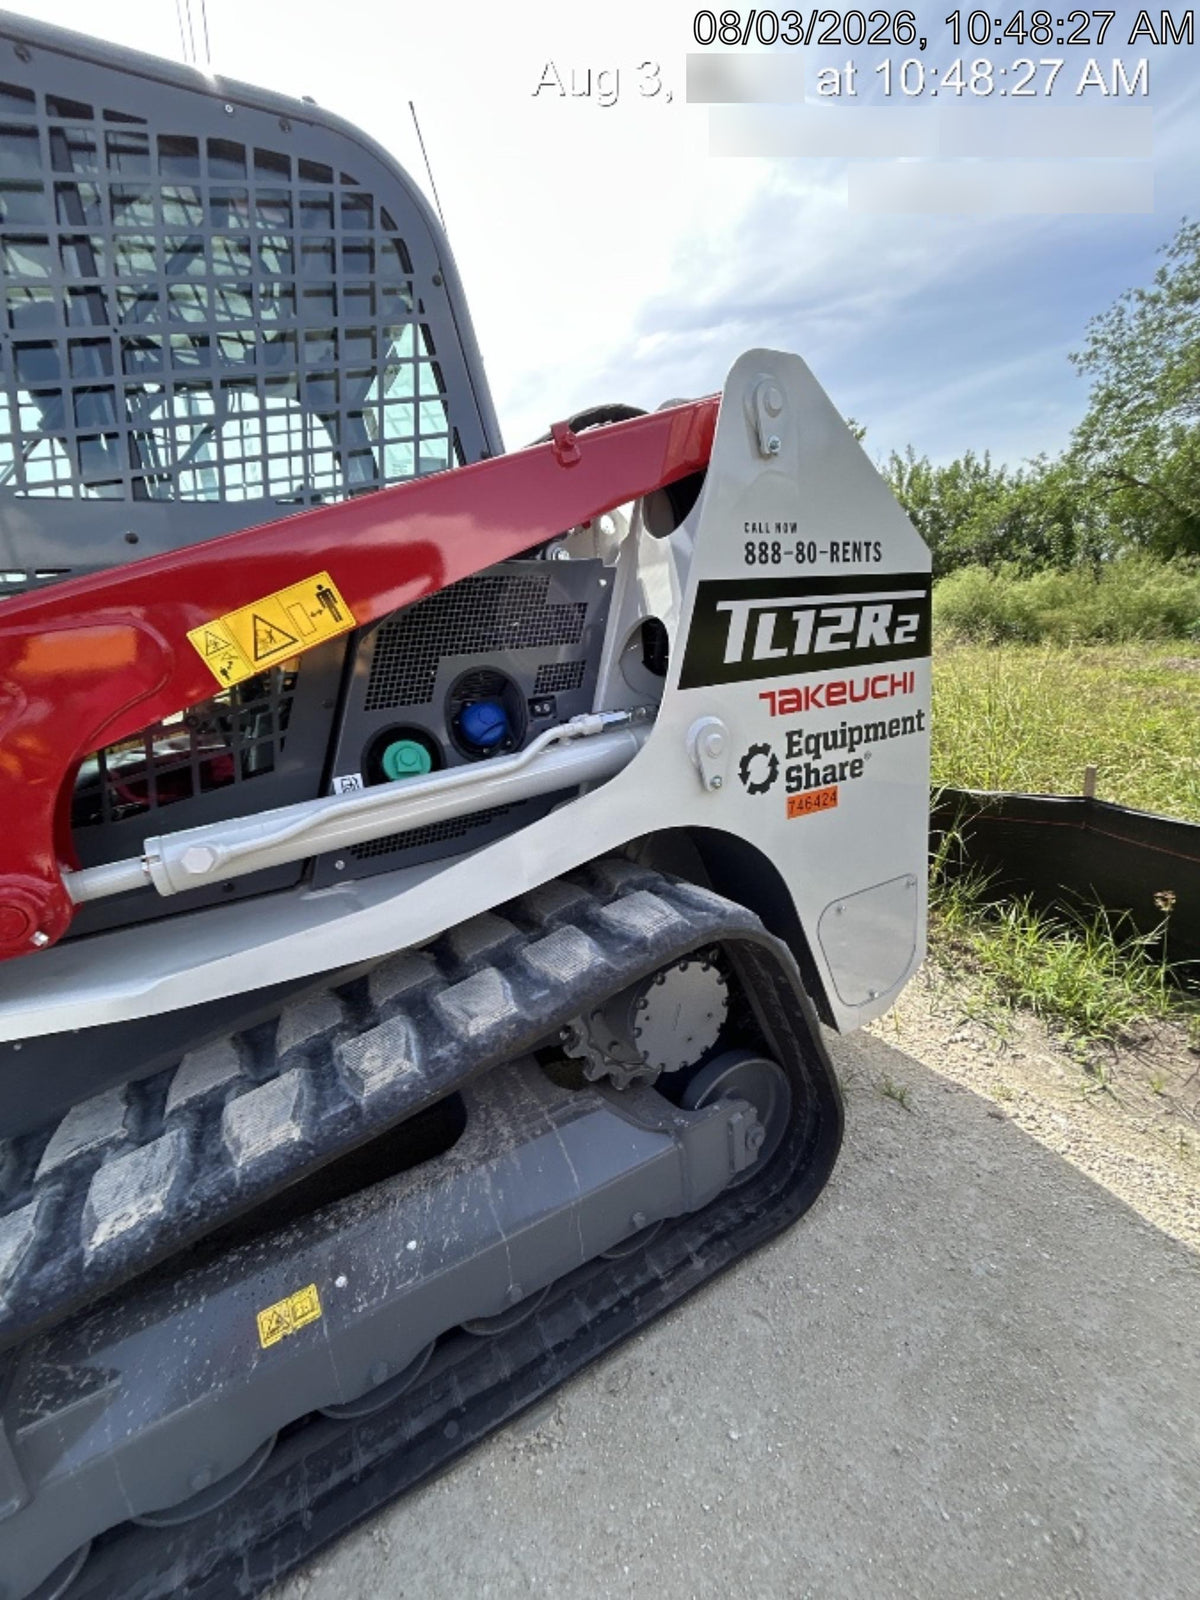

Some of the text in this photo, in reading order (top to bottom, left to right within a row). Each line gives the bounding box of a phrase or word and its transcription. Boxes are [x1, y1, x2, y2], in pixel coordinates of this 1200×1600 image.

[744, 522, 798, 534] CALL NOW
[744, 541, 882, 565] 888-80-RENTS
[785, 709, 926, 760] Equipment
